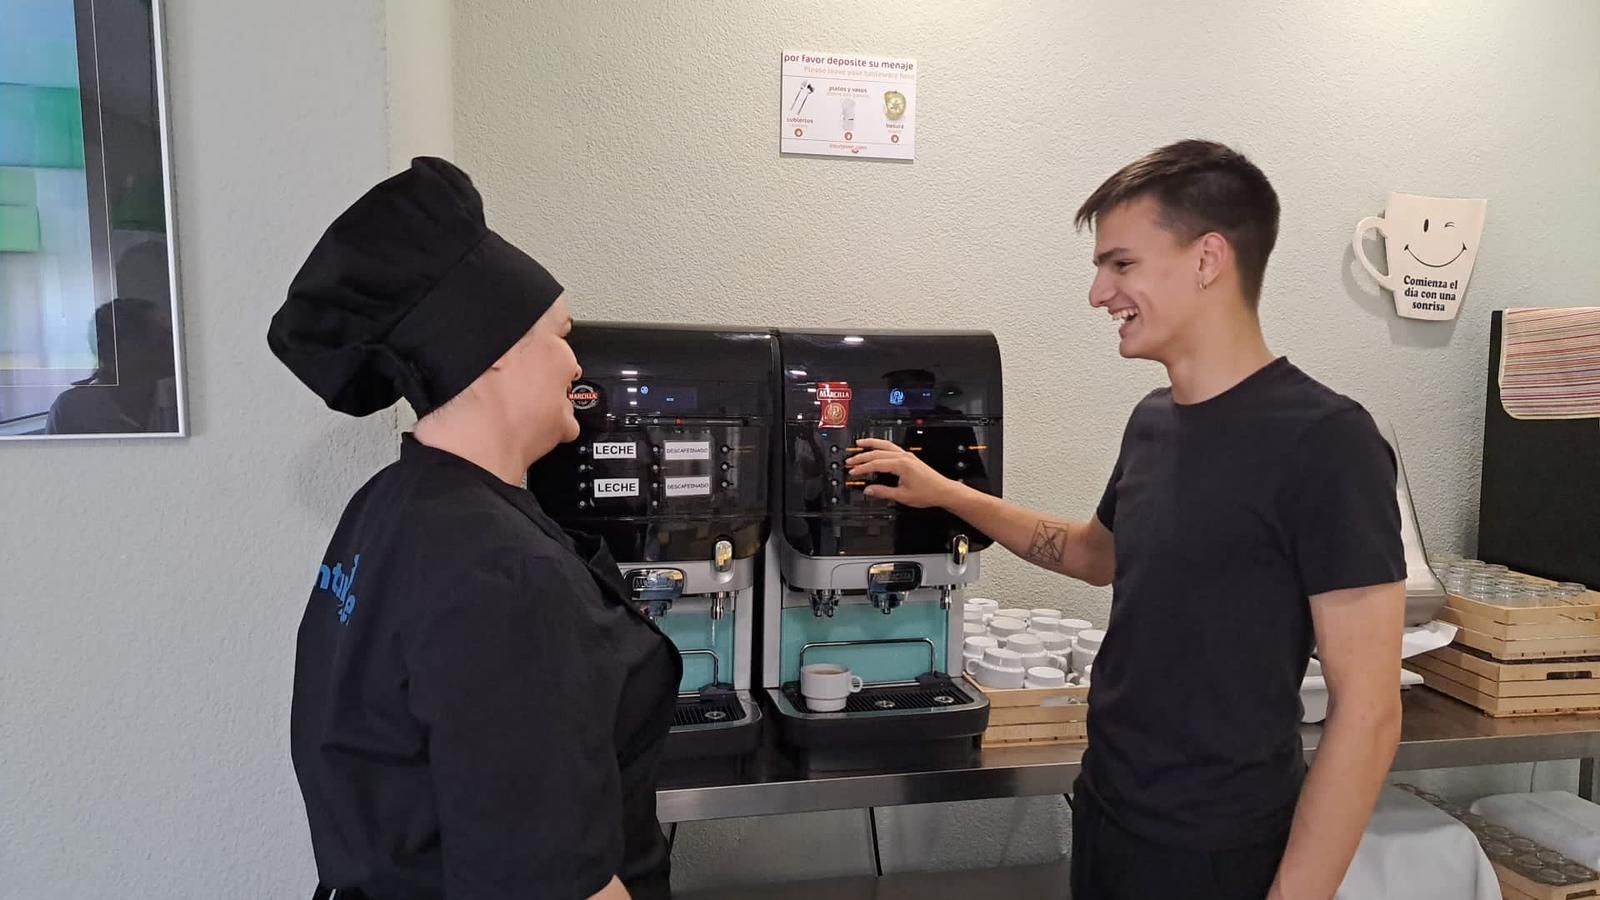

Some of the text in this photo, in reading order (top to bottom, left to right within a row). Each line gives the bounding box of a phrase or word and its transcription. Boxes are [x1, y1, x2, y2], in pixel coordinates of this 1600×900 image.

[784, 54, 914, 71] por favor deposite su menaje
[1404, 275, 1458, 290] Comienza el
[1421, 291, 1437, 299] con
[1439, 292, 1456, 301] una
[1412, 301, 1445, 311] sonrisa
[819, 390, 850, 398] MARCILLA
[595, 445, 634, 455] LECHE
[597, 483, 636, 493] LECHE
